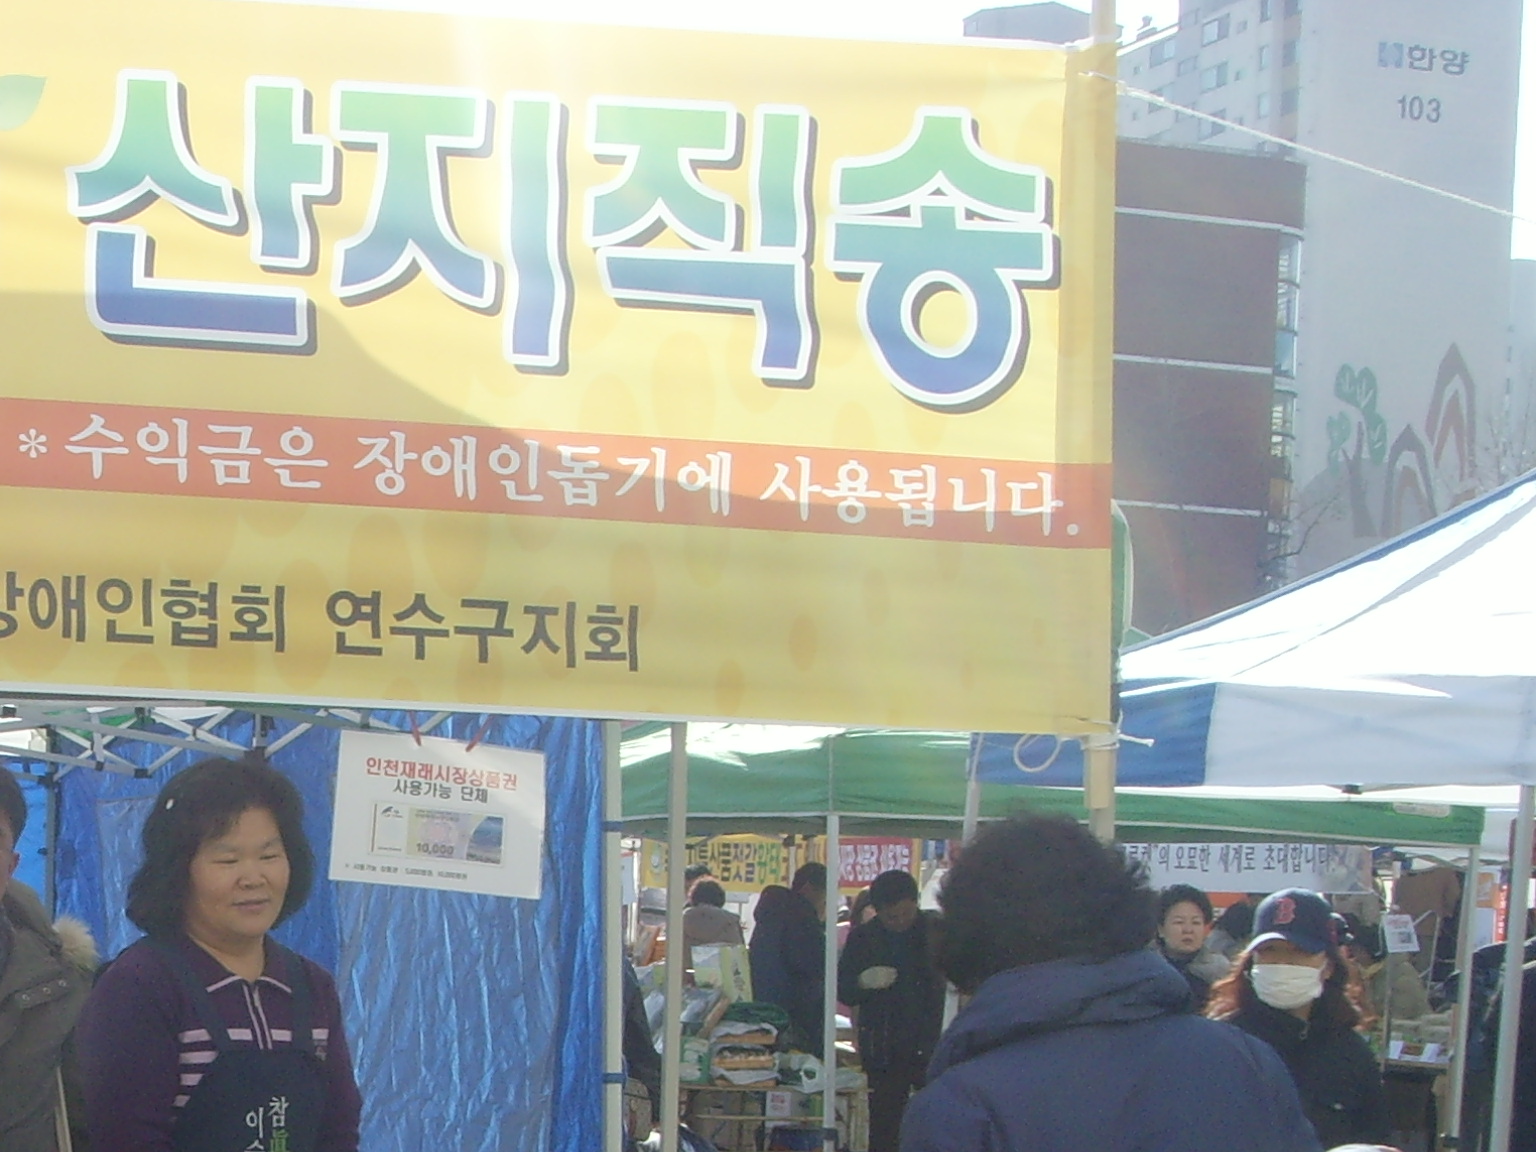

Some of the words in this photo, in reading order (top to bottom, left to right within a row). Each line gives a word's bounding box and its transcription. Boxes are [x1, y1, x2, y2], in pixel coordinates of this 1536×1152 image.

[1406, 44, 1470, 76] 한양
[1397, 95, 1442, 124] 103
[69, 72, 1061, 412] 산지직송
[64, 412, 328, 492] 수익금은
[354, 433, 732, 518] 장애인돕기에
[760, 457, 1082, 538] 사용됩니다.
[325, 588, 641, 672] 연수구지회
[366, 757, 518, 791] 인천재래시장상품권
[393, 779, 452, 799] 사용가능
[461, 786, 488, 803] 단체
[416, 842, 455, 855] 10,000
[1174, 845, 1211, 873] 오묘한
[1218, 845, 1256, 873] 세계로
[1274, 898, 1297, 923] B
